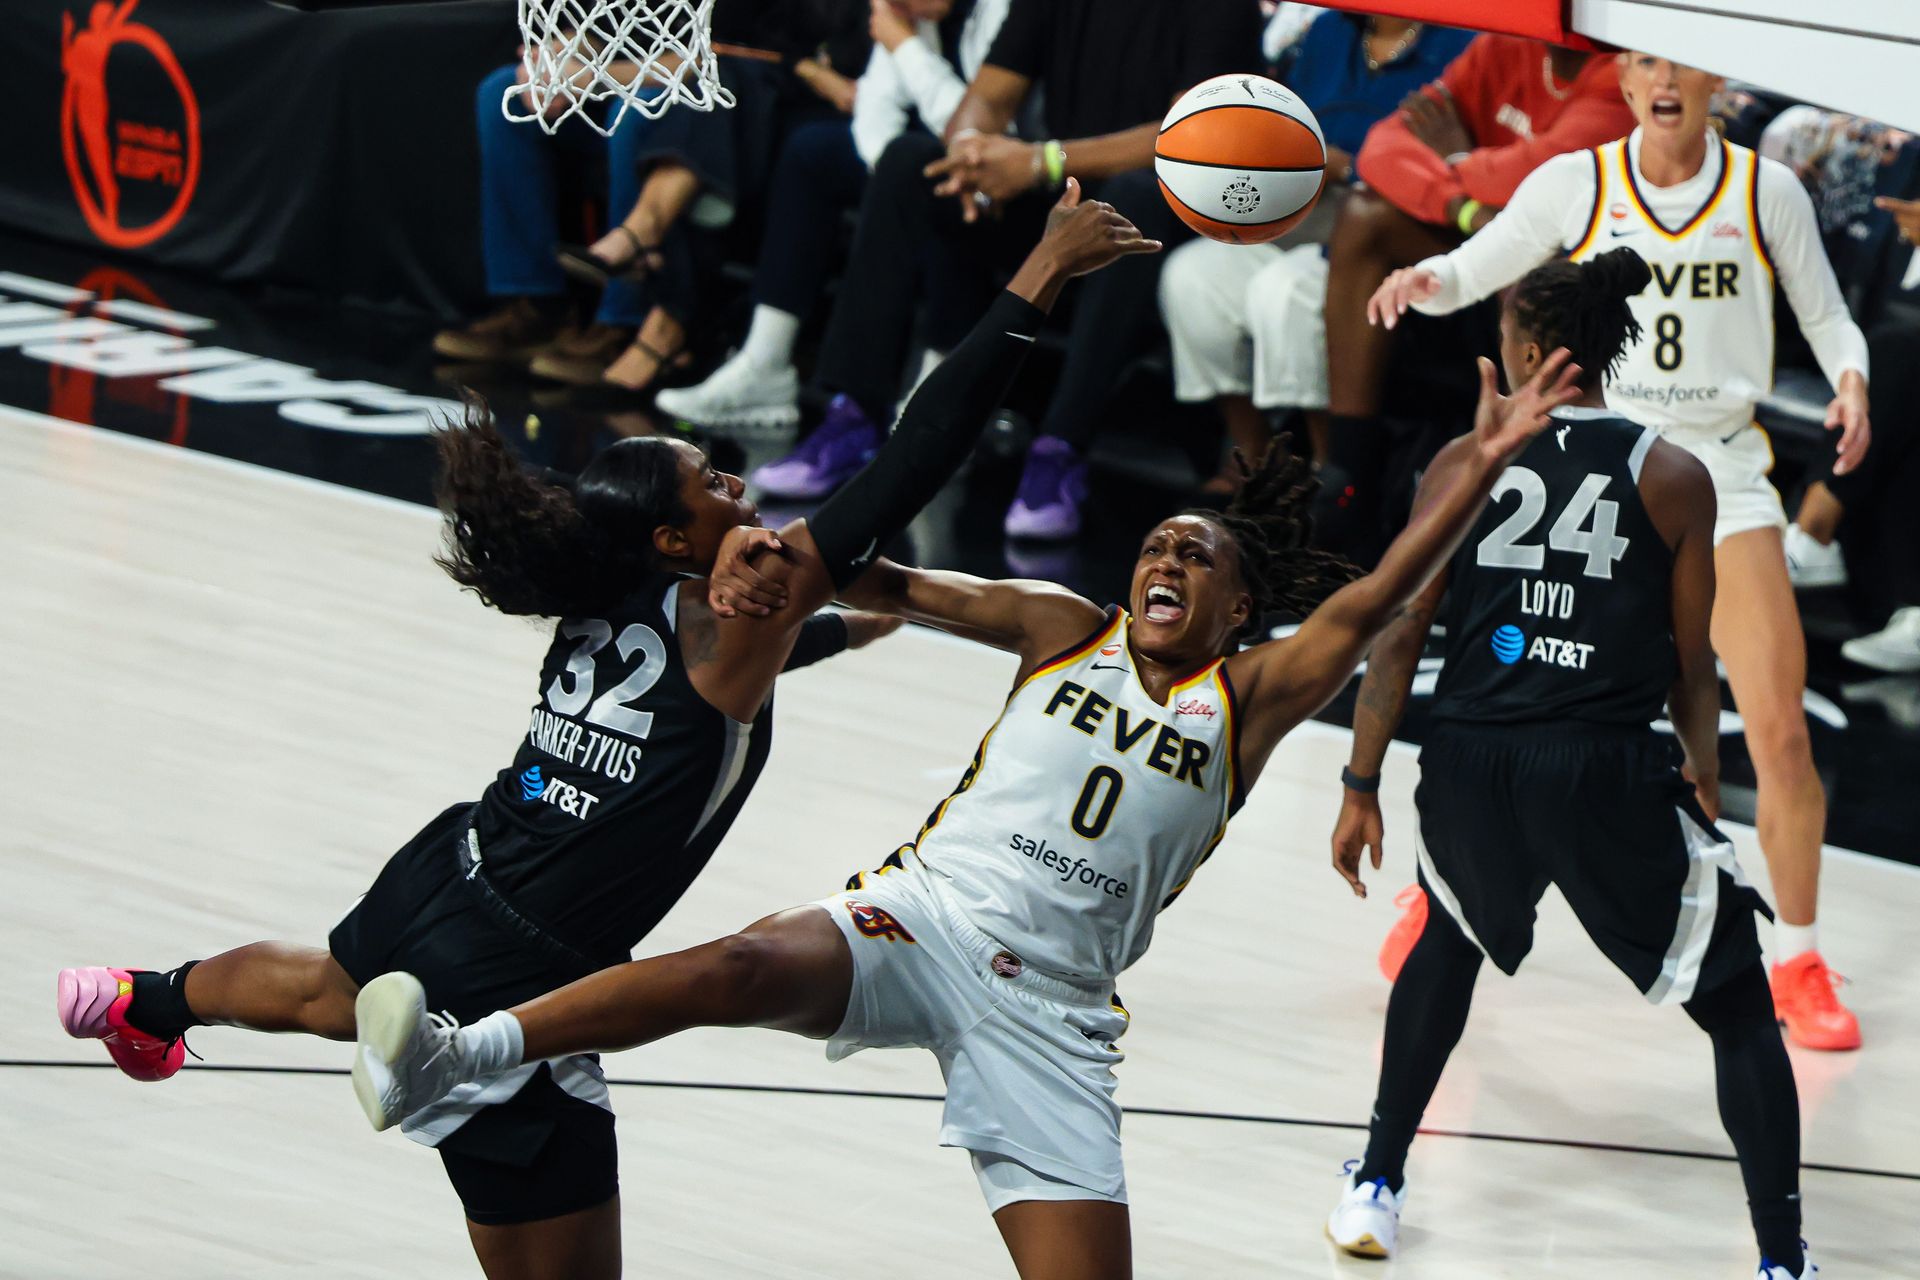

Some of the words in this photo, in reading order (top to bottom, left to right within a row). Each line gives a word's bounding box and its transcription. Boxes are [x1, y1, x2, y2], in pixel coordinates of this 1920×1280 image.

[1651, 260, 1740, 300] VER
[1654, 313, 1684, 372] 8
[1615, 382, 1720, 405] salesforce
[1476, 465, 1630, 580] 24
[1521, 578, 1575, 619] LOYD
[546, 618, 667, 740] 32
[1527, 636, 1595, 670] AT&T
[1043, 680, 1212, 792] FEVER
[1175, 699, 1217, 722] Lilly
[529, 708, 642, 784] PARKER-TYUS
[1070, 764, 1125, 841] 0
[1009, 833, 1129, 899] salesforce
